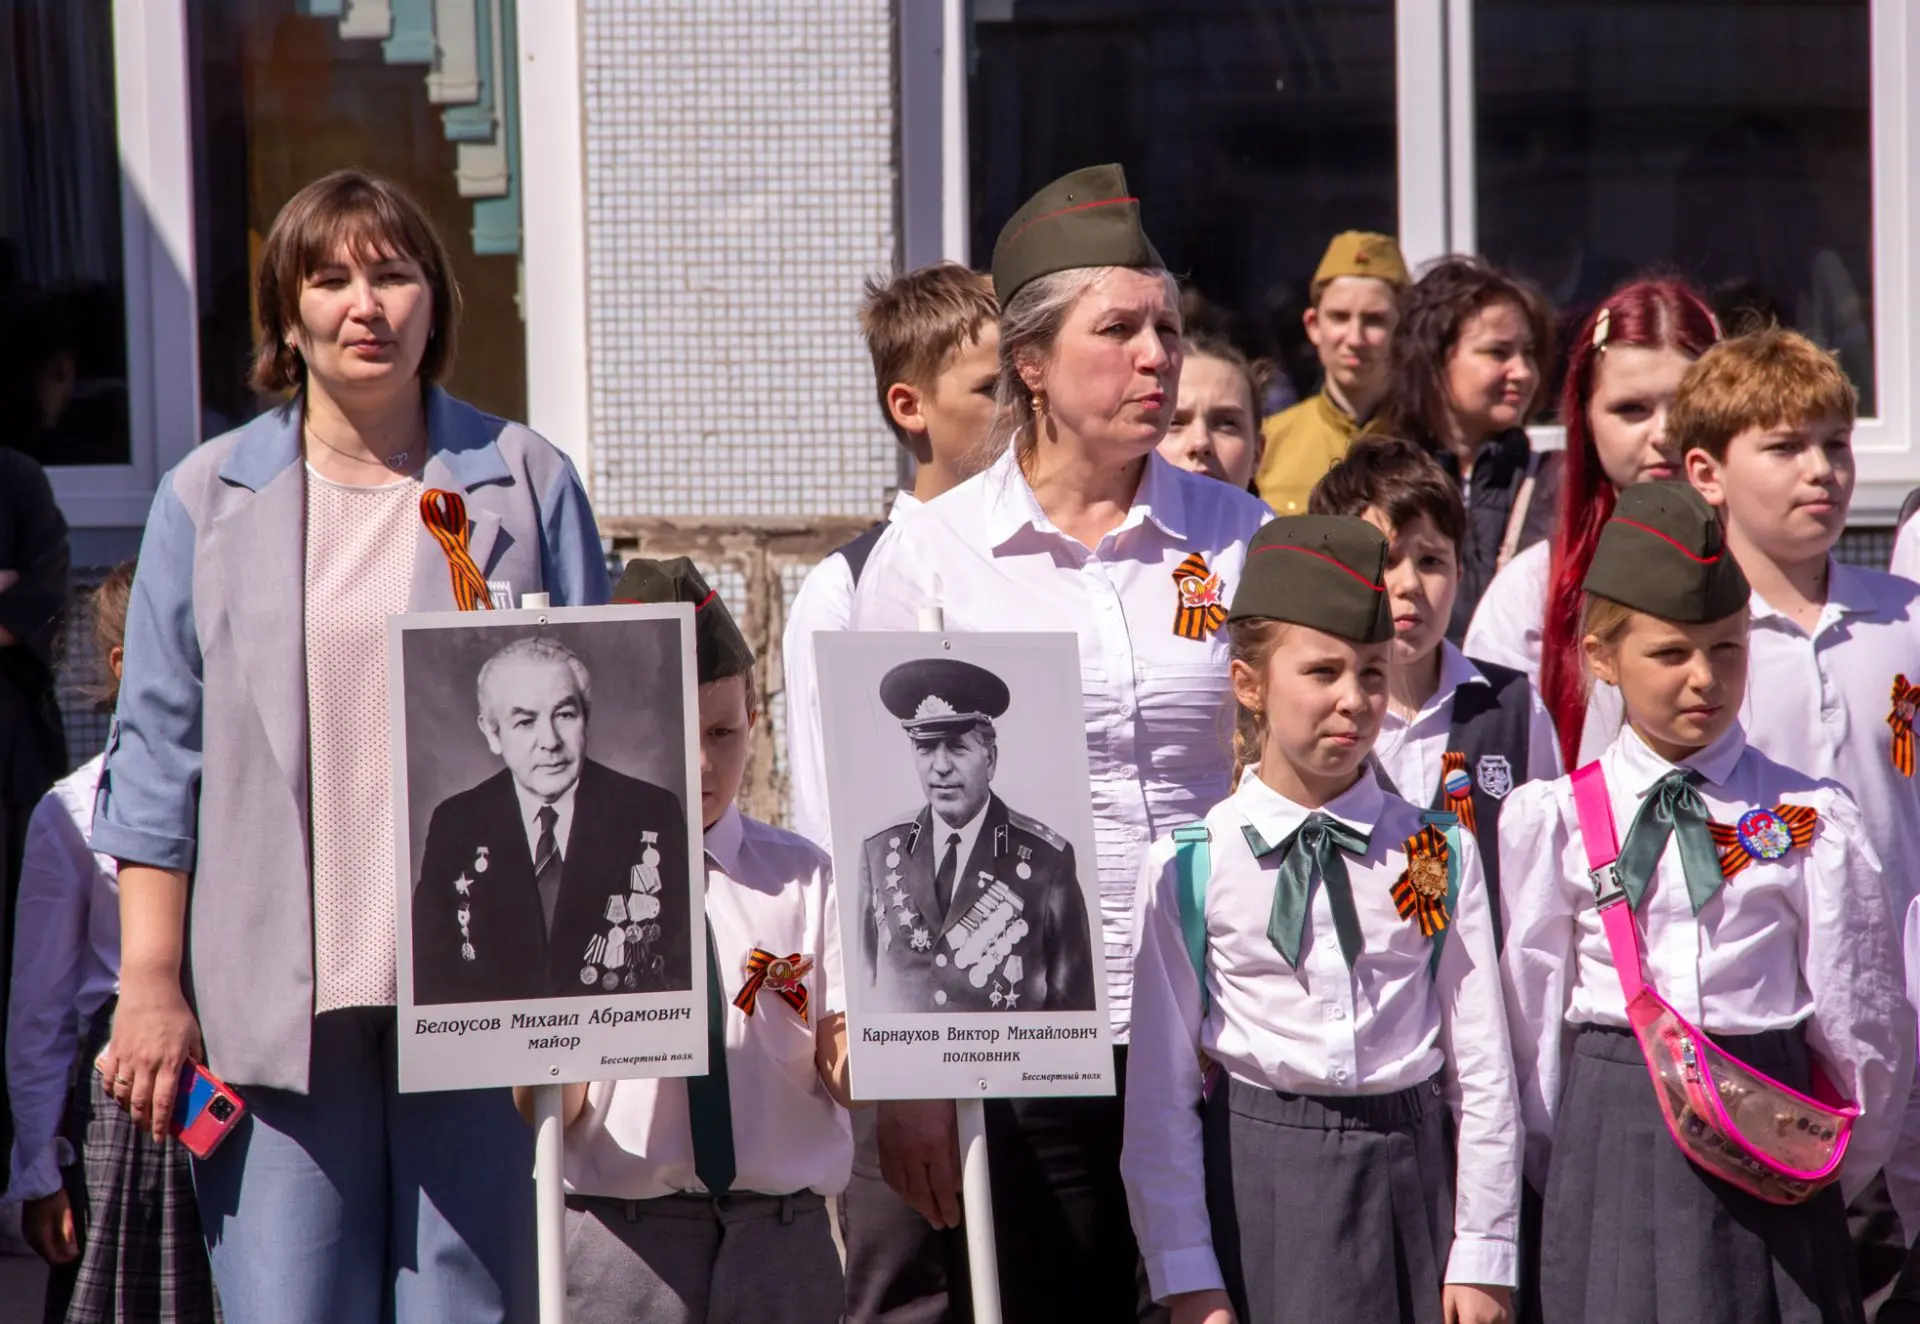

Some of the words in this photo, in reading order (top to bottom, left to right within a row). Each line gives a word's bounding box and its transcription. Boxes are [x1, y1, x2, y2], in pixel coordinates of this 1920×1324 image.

[414, 1017, 502, 1036] Белоусов
[510, 1013, 580, 1030] Михаил
[587, 1006, 692, 1028] Абрамович
[527, 1034, 581, 1051] майор
[862, 1027, 940, 1046] Карнаухов
[946, 1026, 1000, 1045] Виктор
[1007, 1025, 1098, 1041] Михайлович
[600, 1052, 668, 1066] Бессмертный
[670, 1052, 693, 1062] полк
[942, 1051, 1021, 1063] полковник
[1021, 1071, 1080, 1083] Бессмертный
[1081, 1073, 1102, 1081] полк
